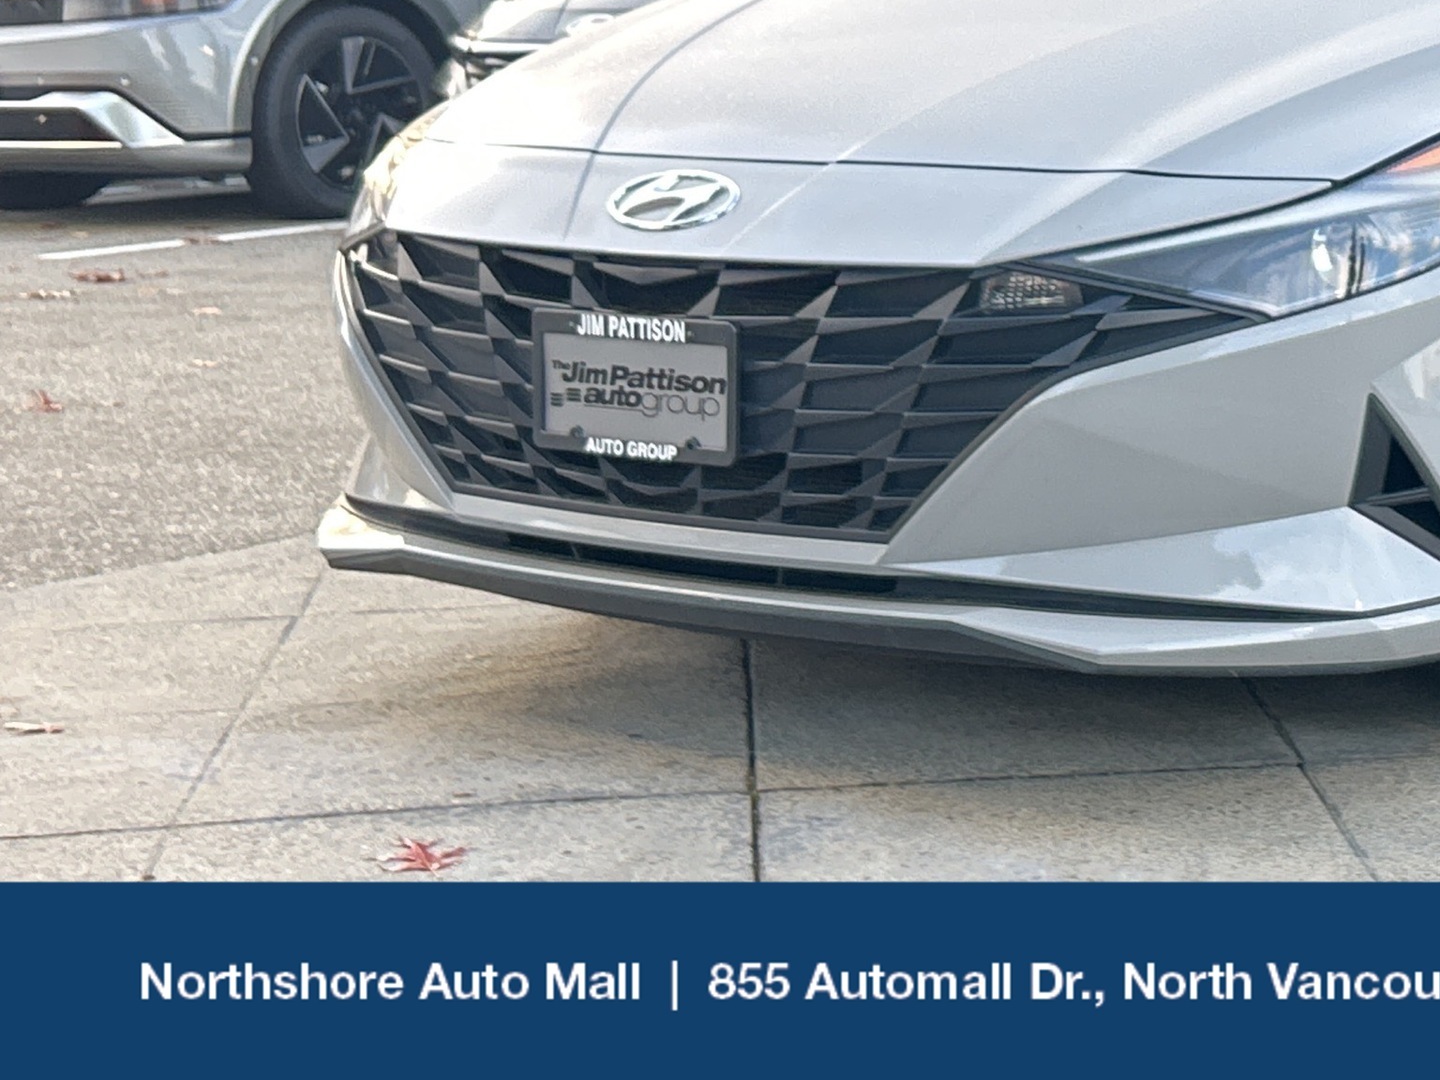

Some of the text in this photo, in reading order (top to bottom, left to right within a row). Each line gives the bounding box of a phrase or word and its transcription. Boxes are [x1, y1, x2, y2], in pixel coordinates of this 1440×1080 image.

[577, 314, 686, 343] JIM PATTISON
[552, 359, 570, 370] The
[585, 437, 678, 460] AUTO GROUP
